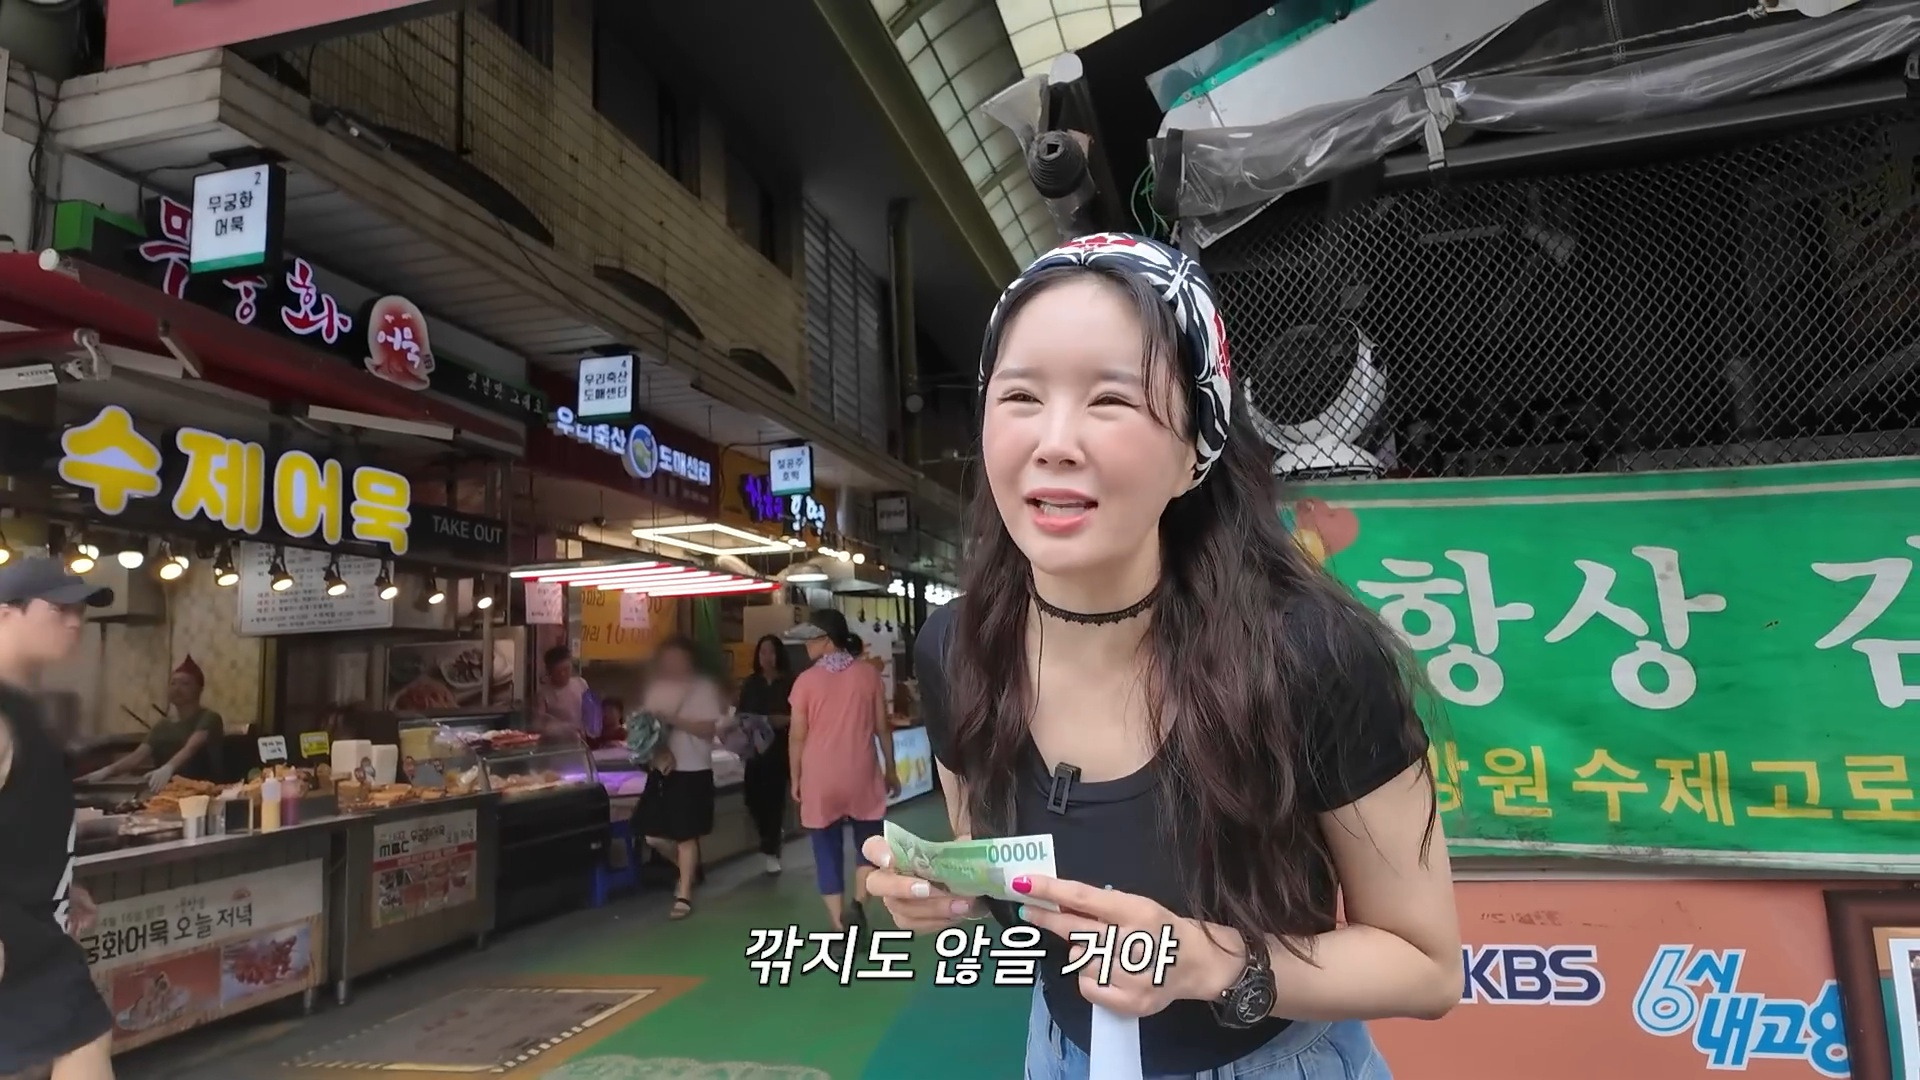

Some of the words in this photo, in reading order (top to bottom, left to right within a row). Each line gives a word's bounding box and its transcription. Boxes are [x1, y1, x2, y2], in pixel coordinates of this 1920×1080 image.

[255, 171, 261, 185] 2
[207, 190, 253, 213] 무궁화
[215, 216, 244, 236] 어묵
[377, 326, 420, 369] 어묵
[584, 371, 628, 386] 우리축산
[584, 387, 627, 402] 도매센터
[556, 406, 627, 455] 우리축산
[659, 444, 711, 486] 도매센터
[59, 405, 411, 555] 수제어묵
[432, 515, 470, 539] TAKE
[474, 523, 503, 544] OUT
[1357, 546, 1727, 710] 항상
[380, 841, 409, 857] MBC
[988, 841, 1047, 864] 10000
[174, 914, 213, 940] 오늘
[217, 903, 252, 927] 저녁
[1461, 947, 1603, 1003] KBS
